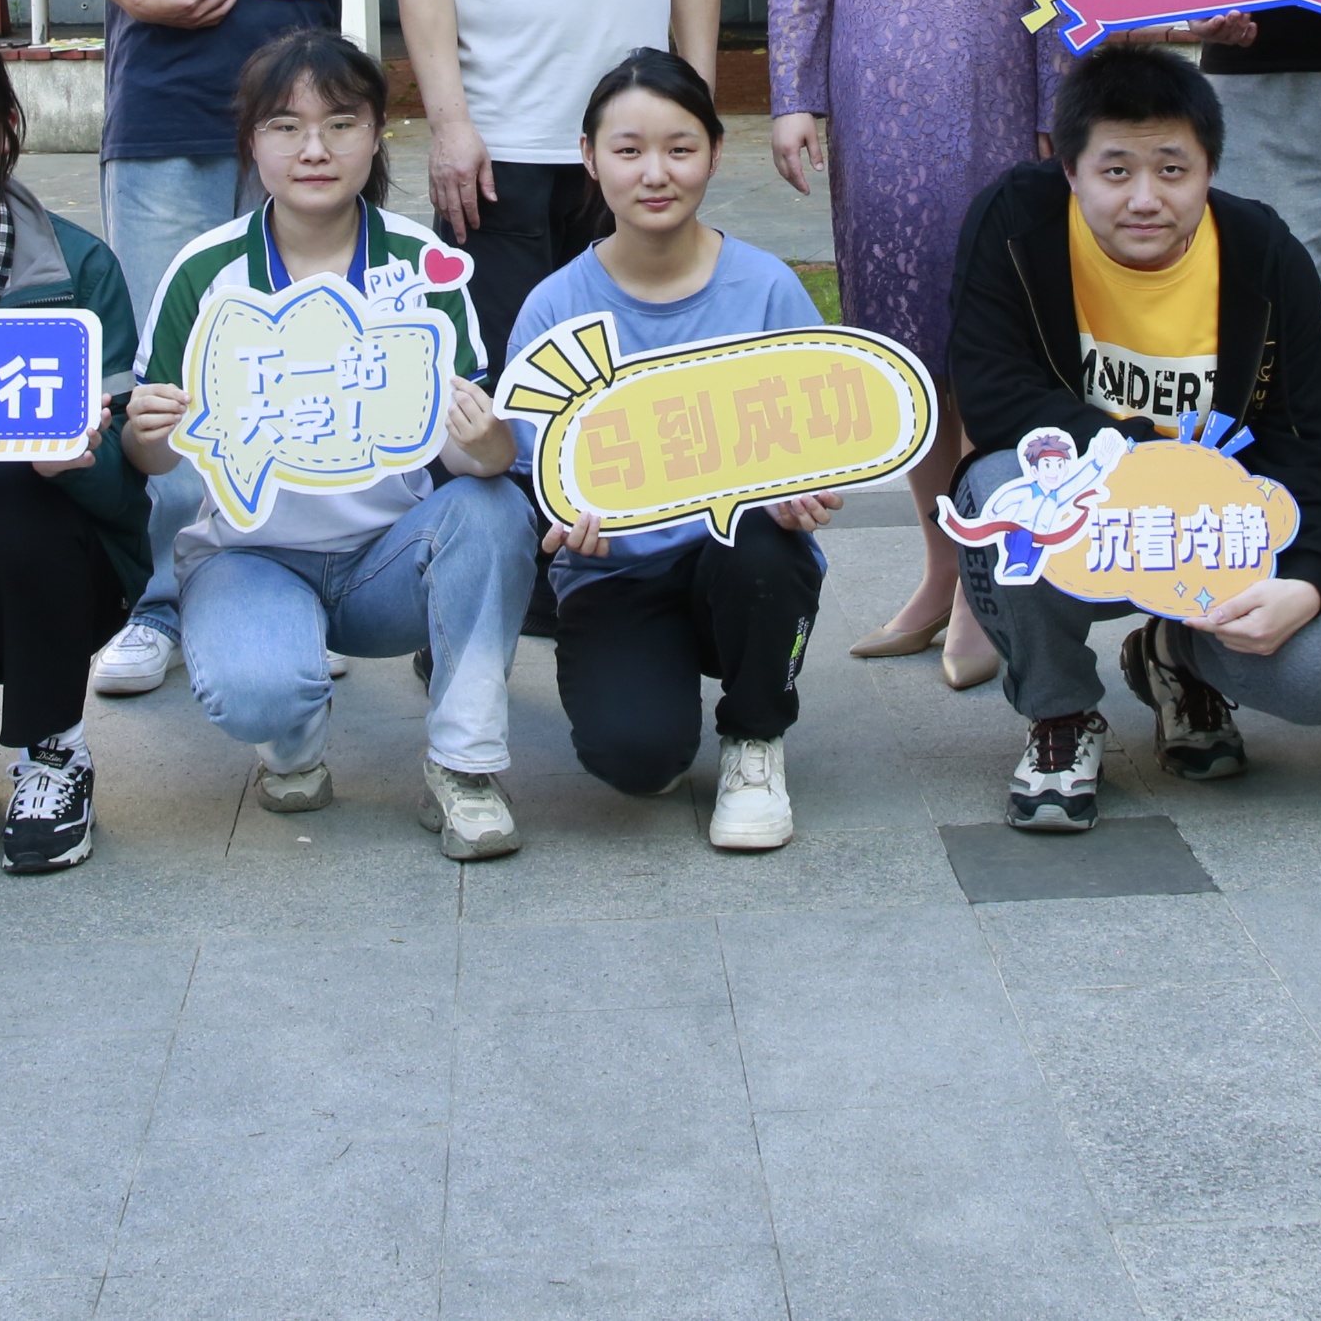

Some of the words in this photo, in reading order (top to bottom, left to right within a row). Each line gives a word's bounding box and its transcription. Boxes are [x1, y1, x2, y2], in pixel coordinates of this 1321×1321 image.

[370, 266, 406, 295] PIU
[235, 343, 387, 395] 下一站
[235, 395, 362, 445] 大学!
[580, 362, 876, 490] 马到成功
[1086, 502, 1270, 571] 沉着冷静
